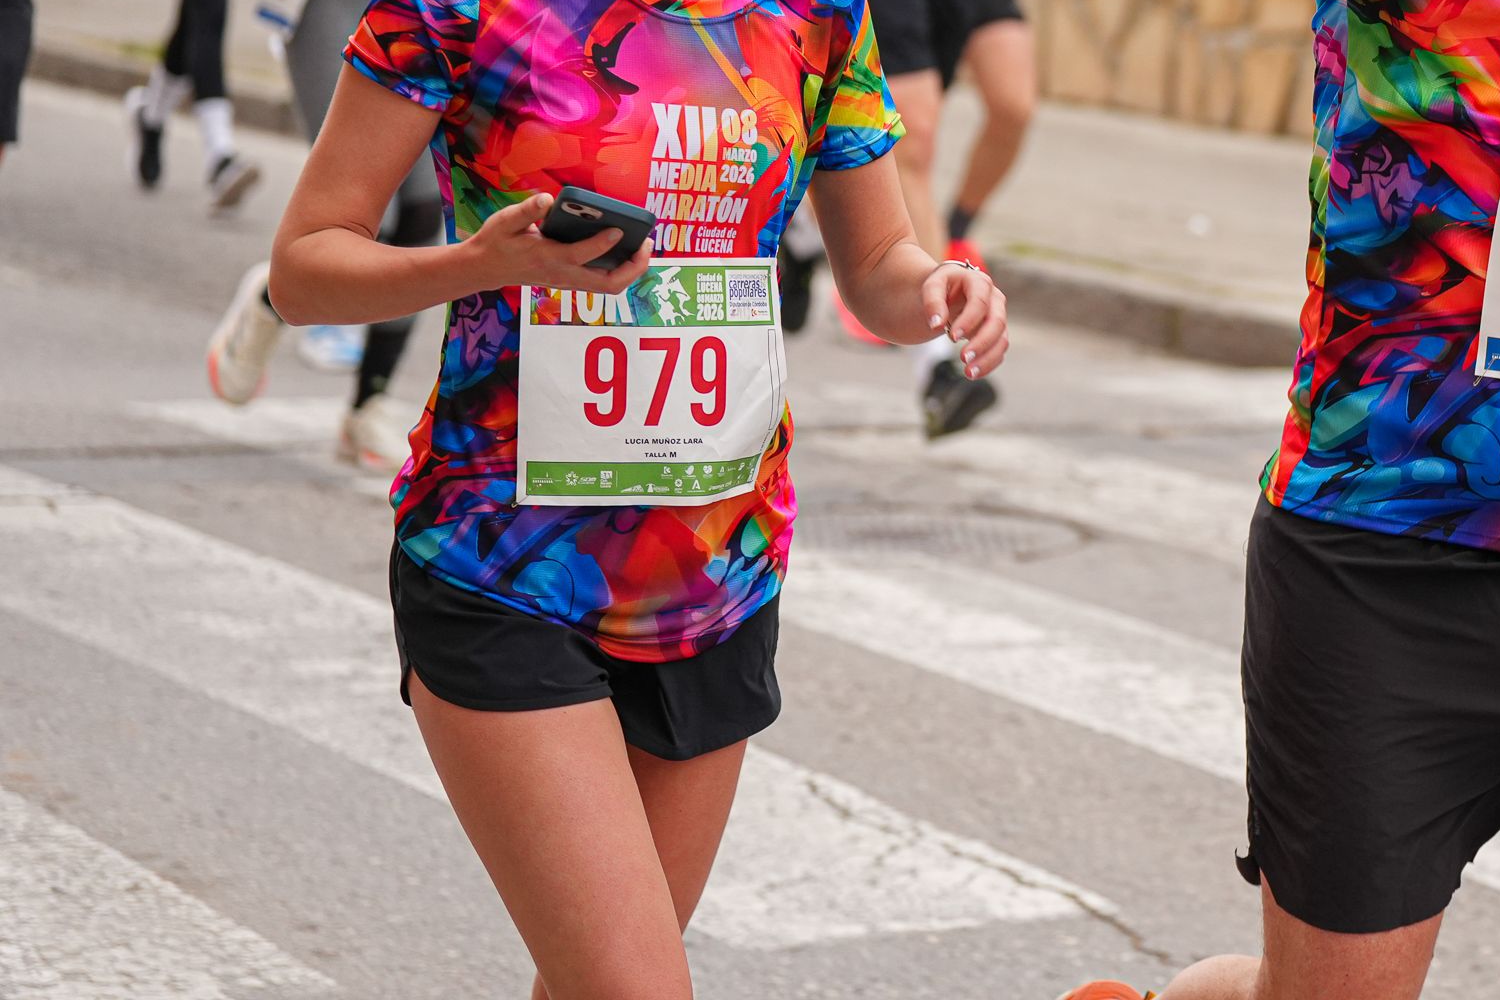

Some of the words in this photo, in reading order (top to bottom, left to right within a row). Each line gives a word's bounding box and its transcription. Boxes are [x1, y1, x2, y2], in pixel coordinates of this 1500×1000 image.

[651, 103, 718, 162] XII
[721, 108, 758, 145] 08
[722, 147, 757, 163] MARZO
[648, 161, 717, 192] MEDIA
[720, 164, 755, 184] 2026
[645, 190, 749, 224] MARATÓN
[655, 223, 695, 252] 10K
[697, 227, 725, 239] Ciudad
[727, 228, 737, 239] de
[695, 238, 733, 253] LUCENA
[697, 281, 723, 293] LUCENA
[729, 280, 760, 289] carreras
[729, 287, 767, 300] populares
[551, 287, 633, 324] 10K
[697, 304, 724, 320] 2026
[583, 336, 728, 427] 979
[652, 437, 681, 445] MUÑOZ
